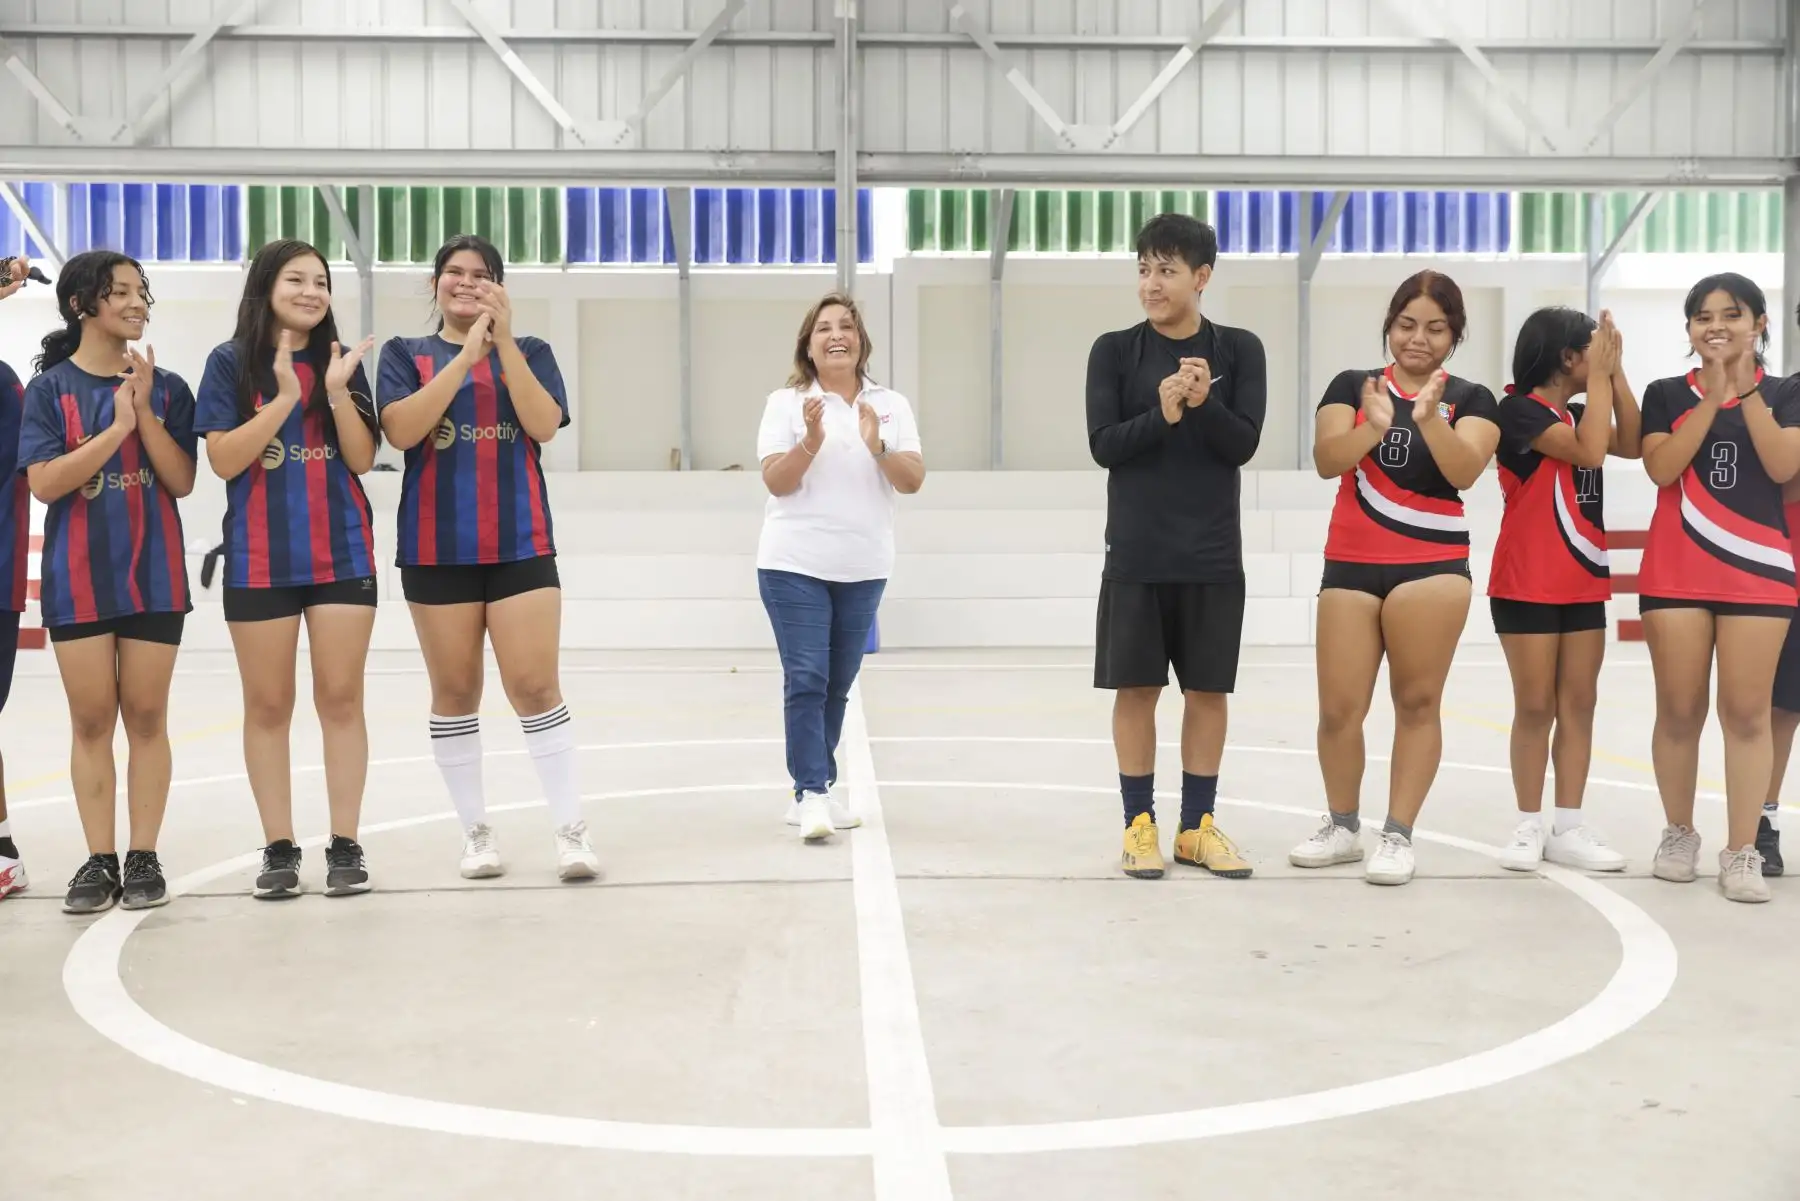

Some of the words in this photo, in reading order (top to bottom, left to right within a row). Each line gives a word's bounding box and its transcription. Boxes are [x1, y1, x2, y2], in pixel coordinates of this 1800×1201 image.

[460, 421, 519, 444] Spotify
[1379, 426, 1412, 468] 8
[1710, 441, 1738, 490] 3
